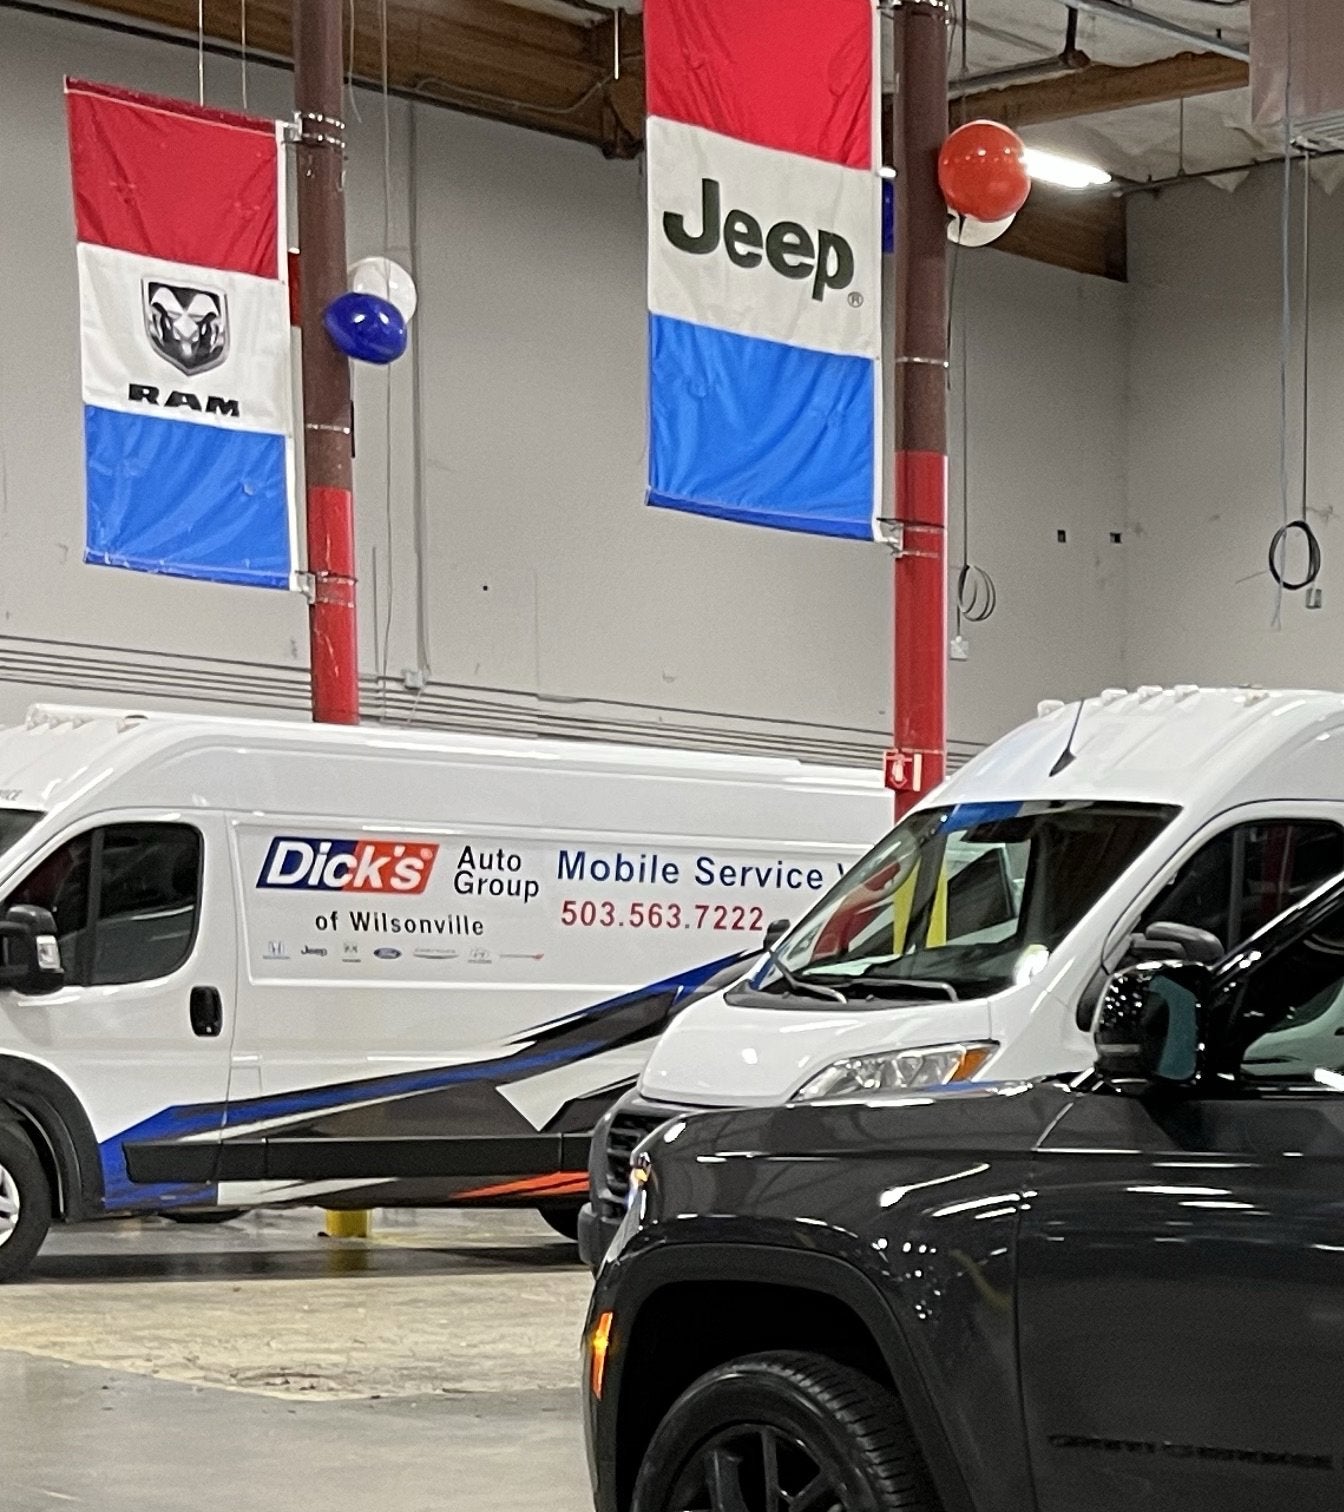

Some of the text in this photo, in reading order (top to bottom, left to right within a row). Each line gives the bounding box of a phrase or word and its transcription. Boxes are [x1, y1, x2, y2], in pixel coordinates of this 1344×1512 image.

[663, 178, 854, 302] Jeep
[129, 383, 240, 418] RAM
[267, 841, 425, 891] Dick's
[457, 845, 522, 872] Auto
[557, 850, 824, 889] Mobile Service
[454, 870, 540, 903] Group
[315, 911, 484, 935] of Wilsonville
[561, 900, 764, 931] 503.563.7222
